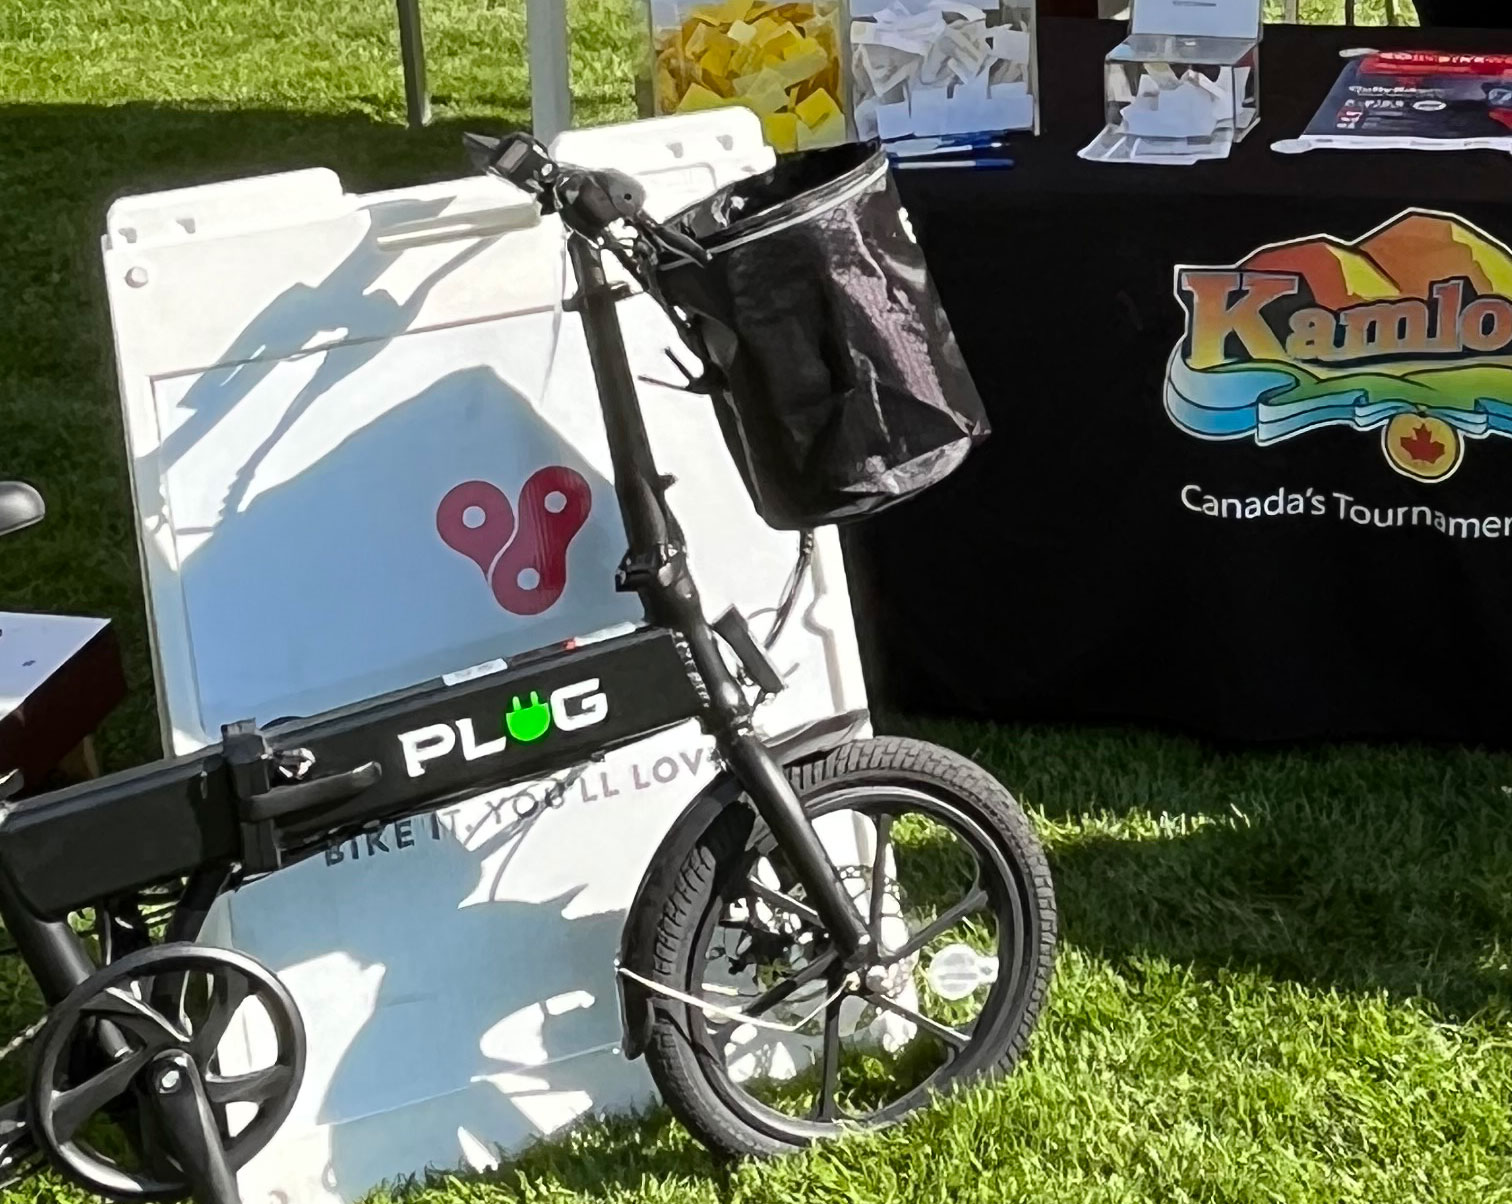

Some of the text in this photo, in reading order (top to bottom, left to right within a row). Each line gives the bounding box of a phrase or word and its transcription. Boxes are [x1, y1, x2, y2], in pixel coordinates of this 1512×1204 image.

[1181, 484, 1327, 520] Canada's
[397, 677, 608, 779] PLUG
[325, 819, 415, 867] BIKE
[631, 748, 704, 790] LOV
